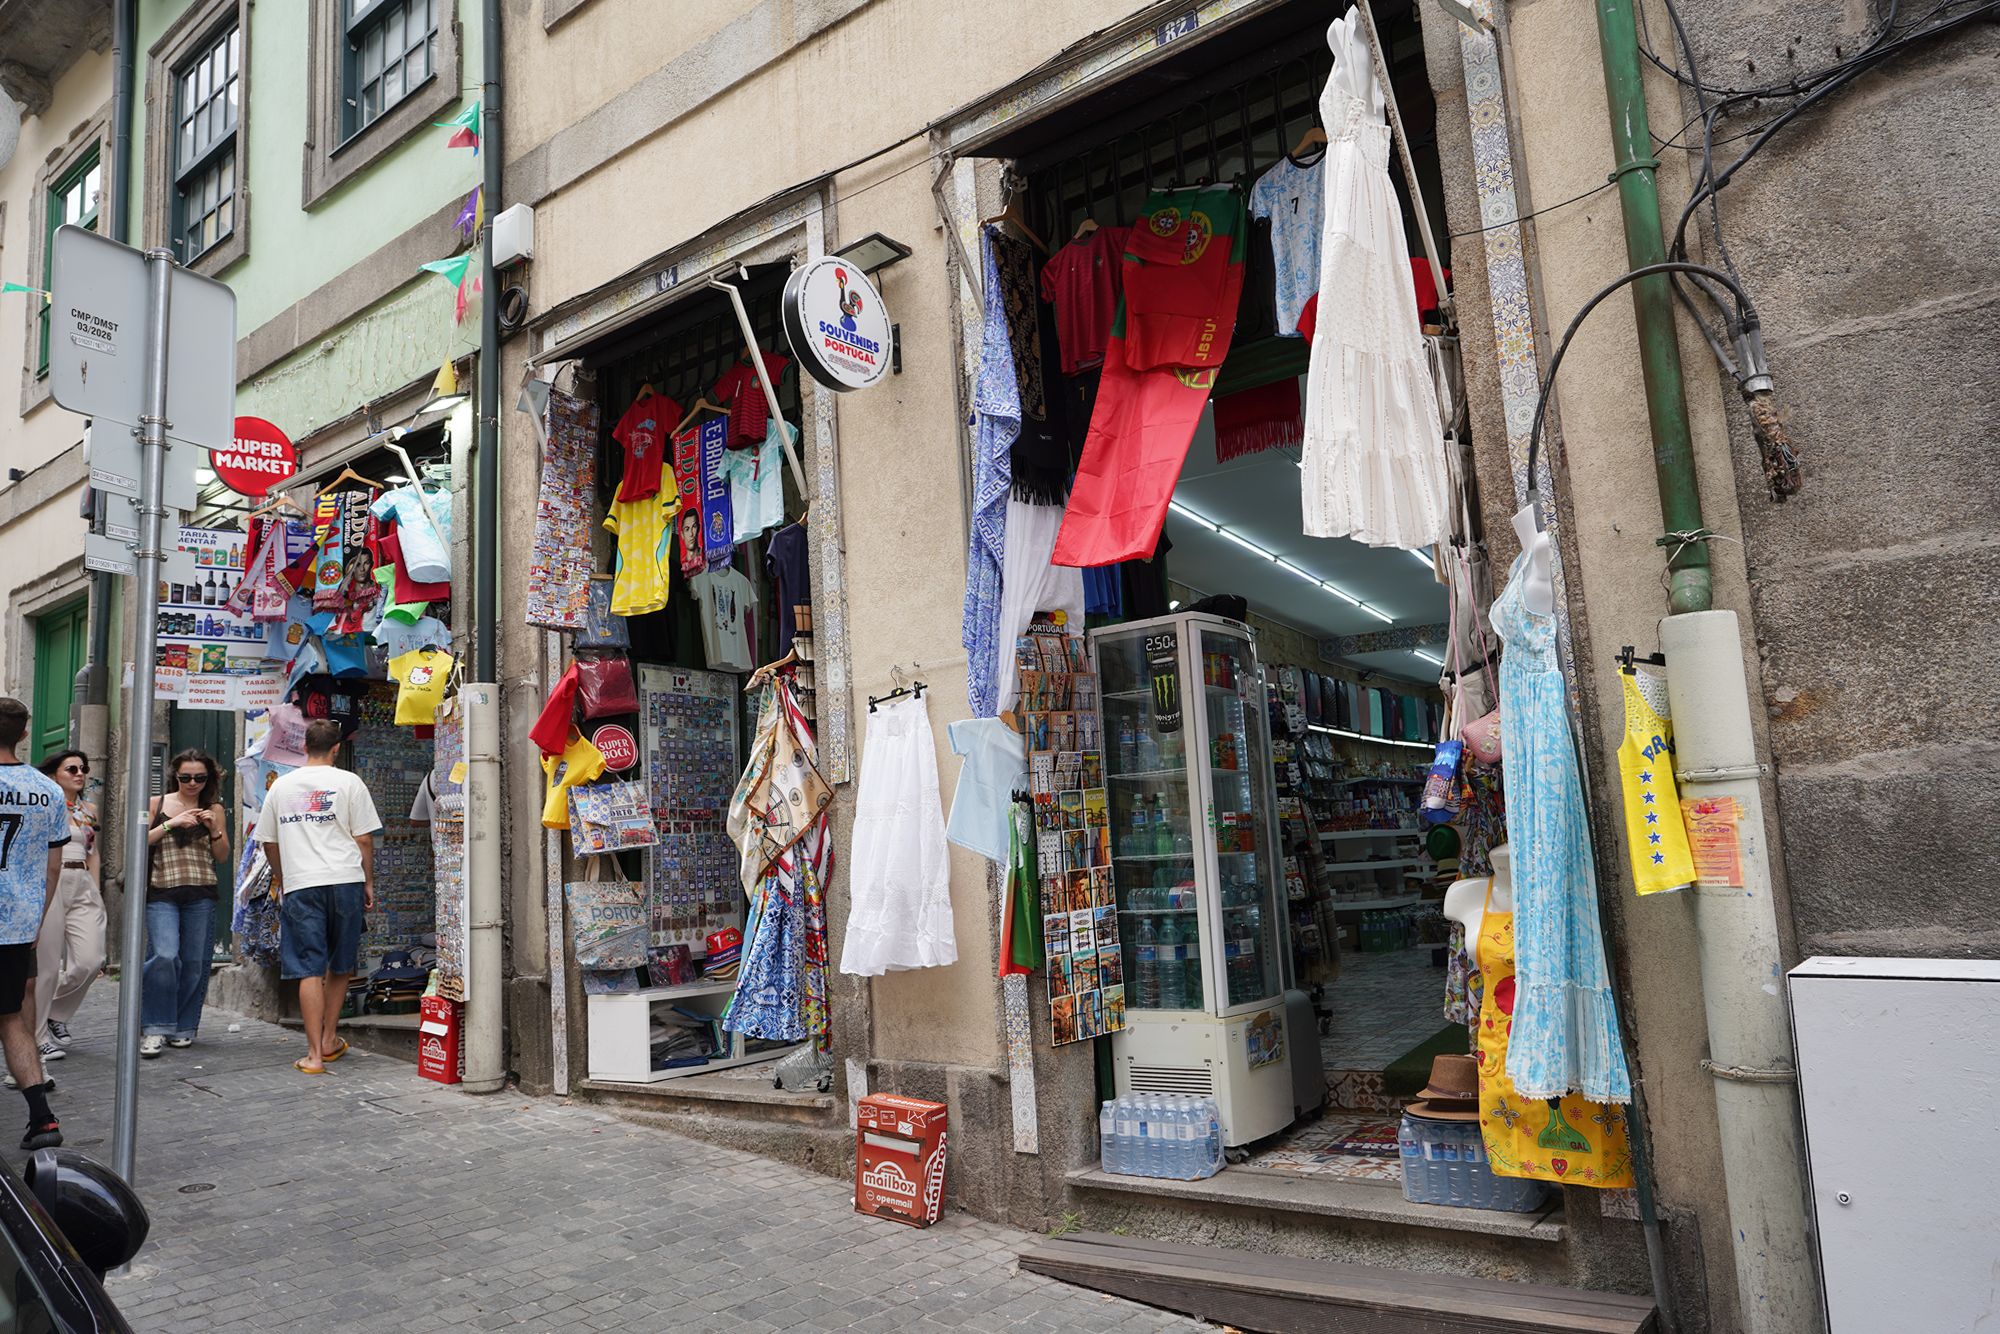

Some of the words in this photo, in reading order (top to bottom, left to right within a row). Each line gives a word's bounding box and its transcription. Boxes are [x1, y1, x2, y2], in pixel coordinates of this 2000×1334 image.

[71, 308, 119, 332] CMP/DMST
[77, 322, 112, 341] 03/2026
[819, 320, 880, 354] SOUVENIRS
[825, 337, 876, 366] PORTUGAL
[230, 438, 283, 458] SUPER
[216, 451, 292, 476] MARKET
[752, 459, 760, 481] 7
[1028, 624, 1065, 634] PORTUGAL
[1145, 635, 1177, 651] 2.50€
[598, 738, 629, 751] SUPER
[602, 747, 631, 760] BOCK
[280, 814, 302, 825] Nude
[305, 813, 337, 824] Project
[591, 906, 639, 921] PORTO
[865, 1172, 915, 1195] mailbox
[929, 1134, 947, 1222] mailbox
[876, 1194, 913, 1209] openmail
